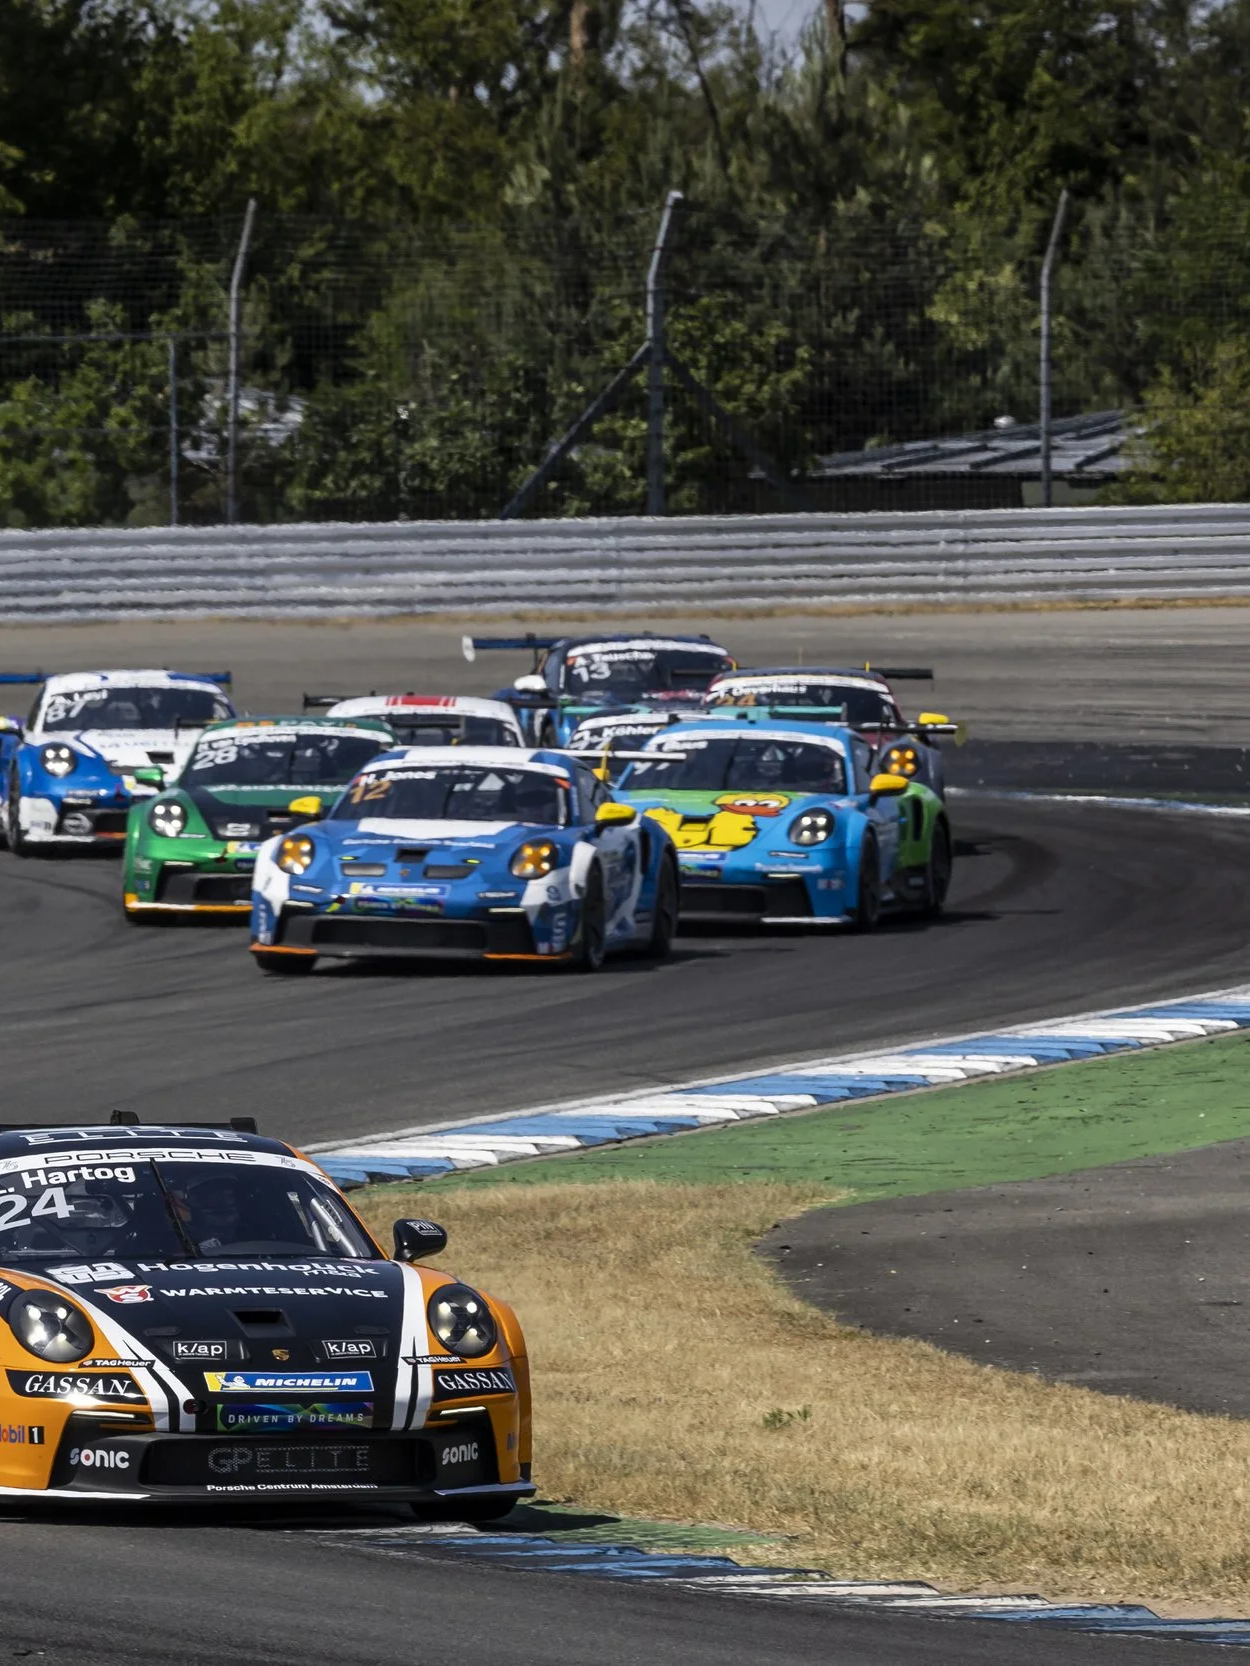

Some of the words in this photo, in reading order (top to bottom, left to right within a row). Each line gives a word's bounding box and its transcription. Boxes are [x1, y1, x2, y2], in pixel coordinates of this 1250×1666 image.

[572, 662, 611, 682] 13
[45, 700, 86, 723] 87
[192, 746, 238, 770] 28
[350, 780, 392, 804] 12
[44, 1151, 256, 1165] PORSCHE
[21, 1167, 136, 1189] Hartog
[160, 1287, 388, 1298] WARMTESERVICE
[25, 1373, 132, 1395] GASSAN
[254, 1378, 357, 1386] MICHELIN
[438, 1371, 516, 1391] GASSAN
[228, 1414, 279, 1424] DRIVEN
[288, 1414, 303, 1423] BY
[310, 1413, 364, 1423] DREAMS
